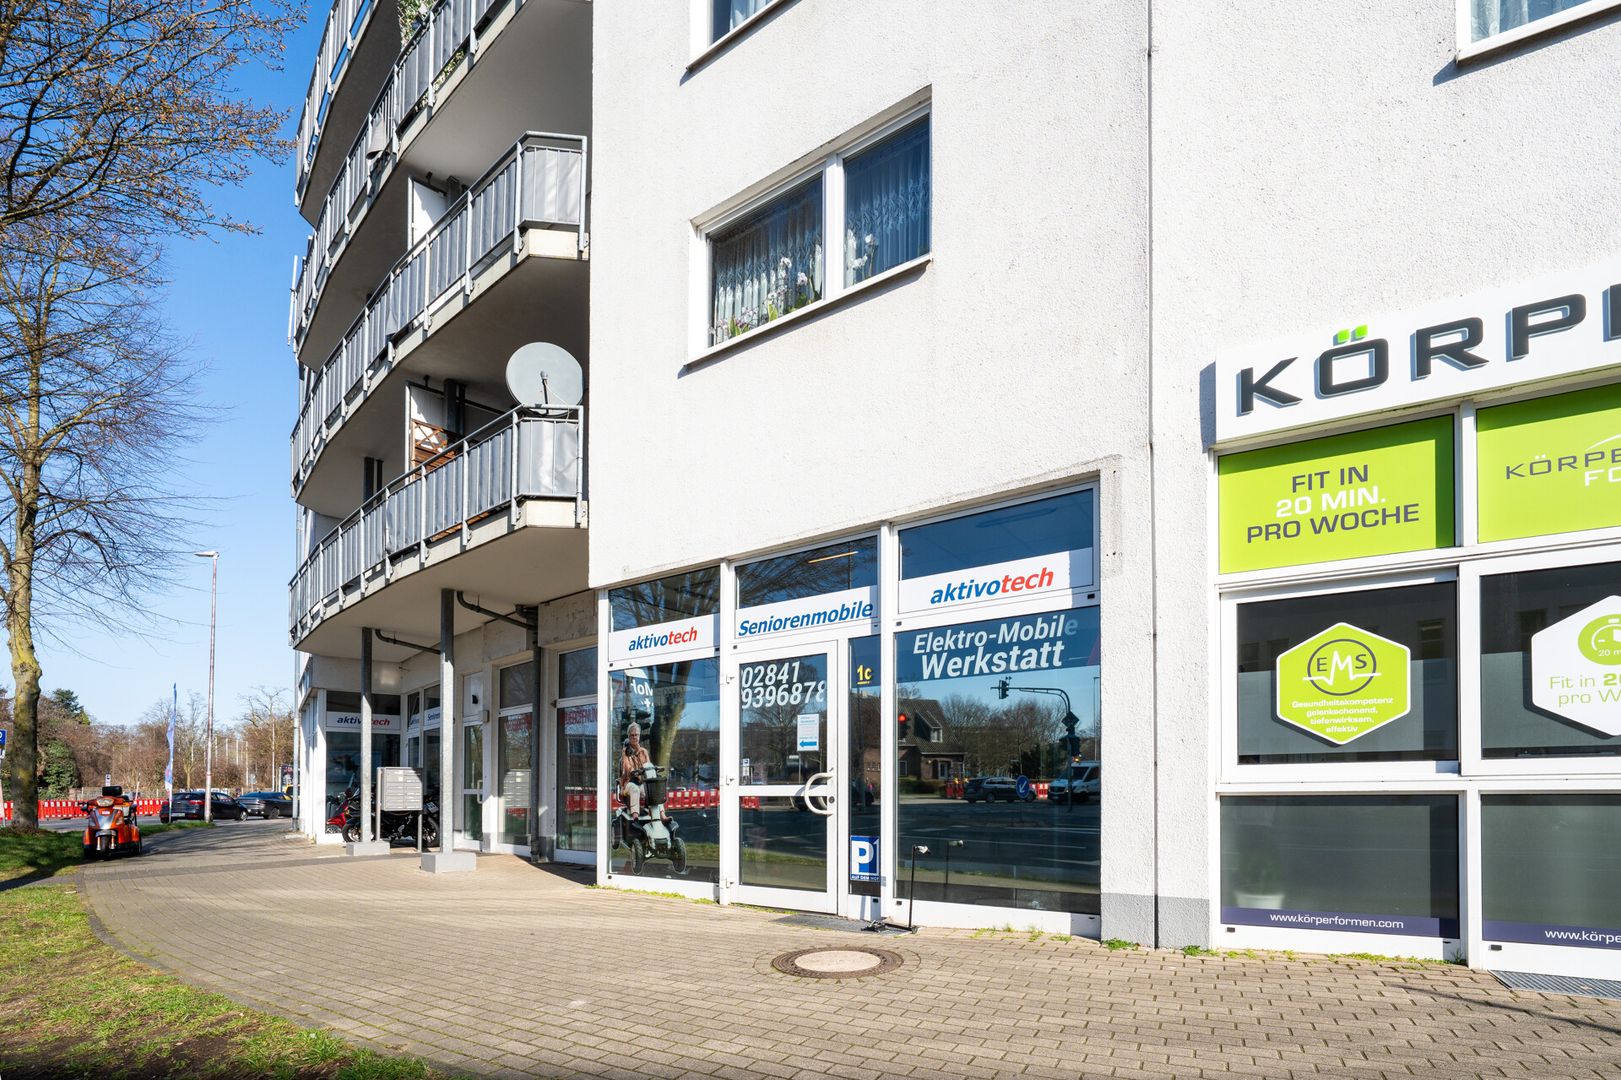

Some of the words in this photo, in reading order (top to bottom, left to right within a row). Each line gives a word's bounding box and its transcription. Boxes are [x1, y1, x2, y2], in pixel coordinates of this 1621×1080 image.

[1291, 470, 1330, 493] FIT
[1340, 464, 1369, 486] IN
[1275, 496, 1312, 518] 20
[1321, 485, 1387, 512] MIN.
[1247, 520, 1301, 544] PRO
[1310, 503, 1420, 535] WOCHE
[930, 567, 1055, 605] aktivotech
[738, 600, 874, 636] Seniorenmobile
[628, 626, 698, 651] aktivotech
[913, 614, 1079, 655] Elektro-Mobile
[921, 640, 1065, 681] Werkstatt
[1598, 648, 1611, 657] 20
[741, 661, 801, 688] 02841
[857, 664, 872, 681] 1c
[1316, 650, 1368, 685] EMS
[1549, 675, 1574, 689] Fit
[1579, 674, 1596, 688] in
[1603, 673, 1621, 687] 2
[741, 680, 826, 709] 9396878
[1292, 697, 1394, 709] Gesundheitskompetenz
[1558, 693, 1592, 708] pro
[336, 715, 391, 727] aktivech
[1306, 707, 1379, 718] gelenkschonend,
[1325, 725, 1359, 733] effektiv
[851, 840, 874, 875] P
[1270, 913, 1404, 929] www.körperformen.com
